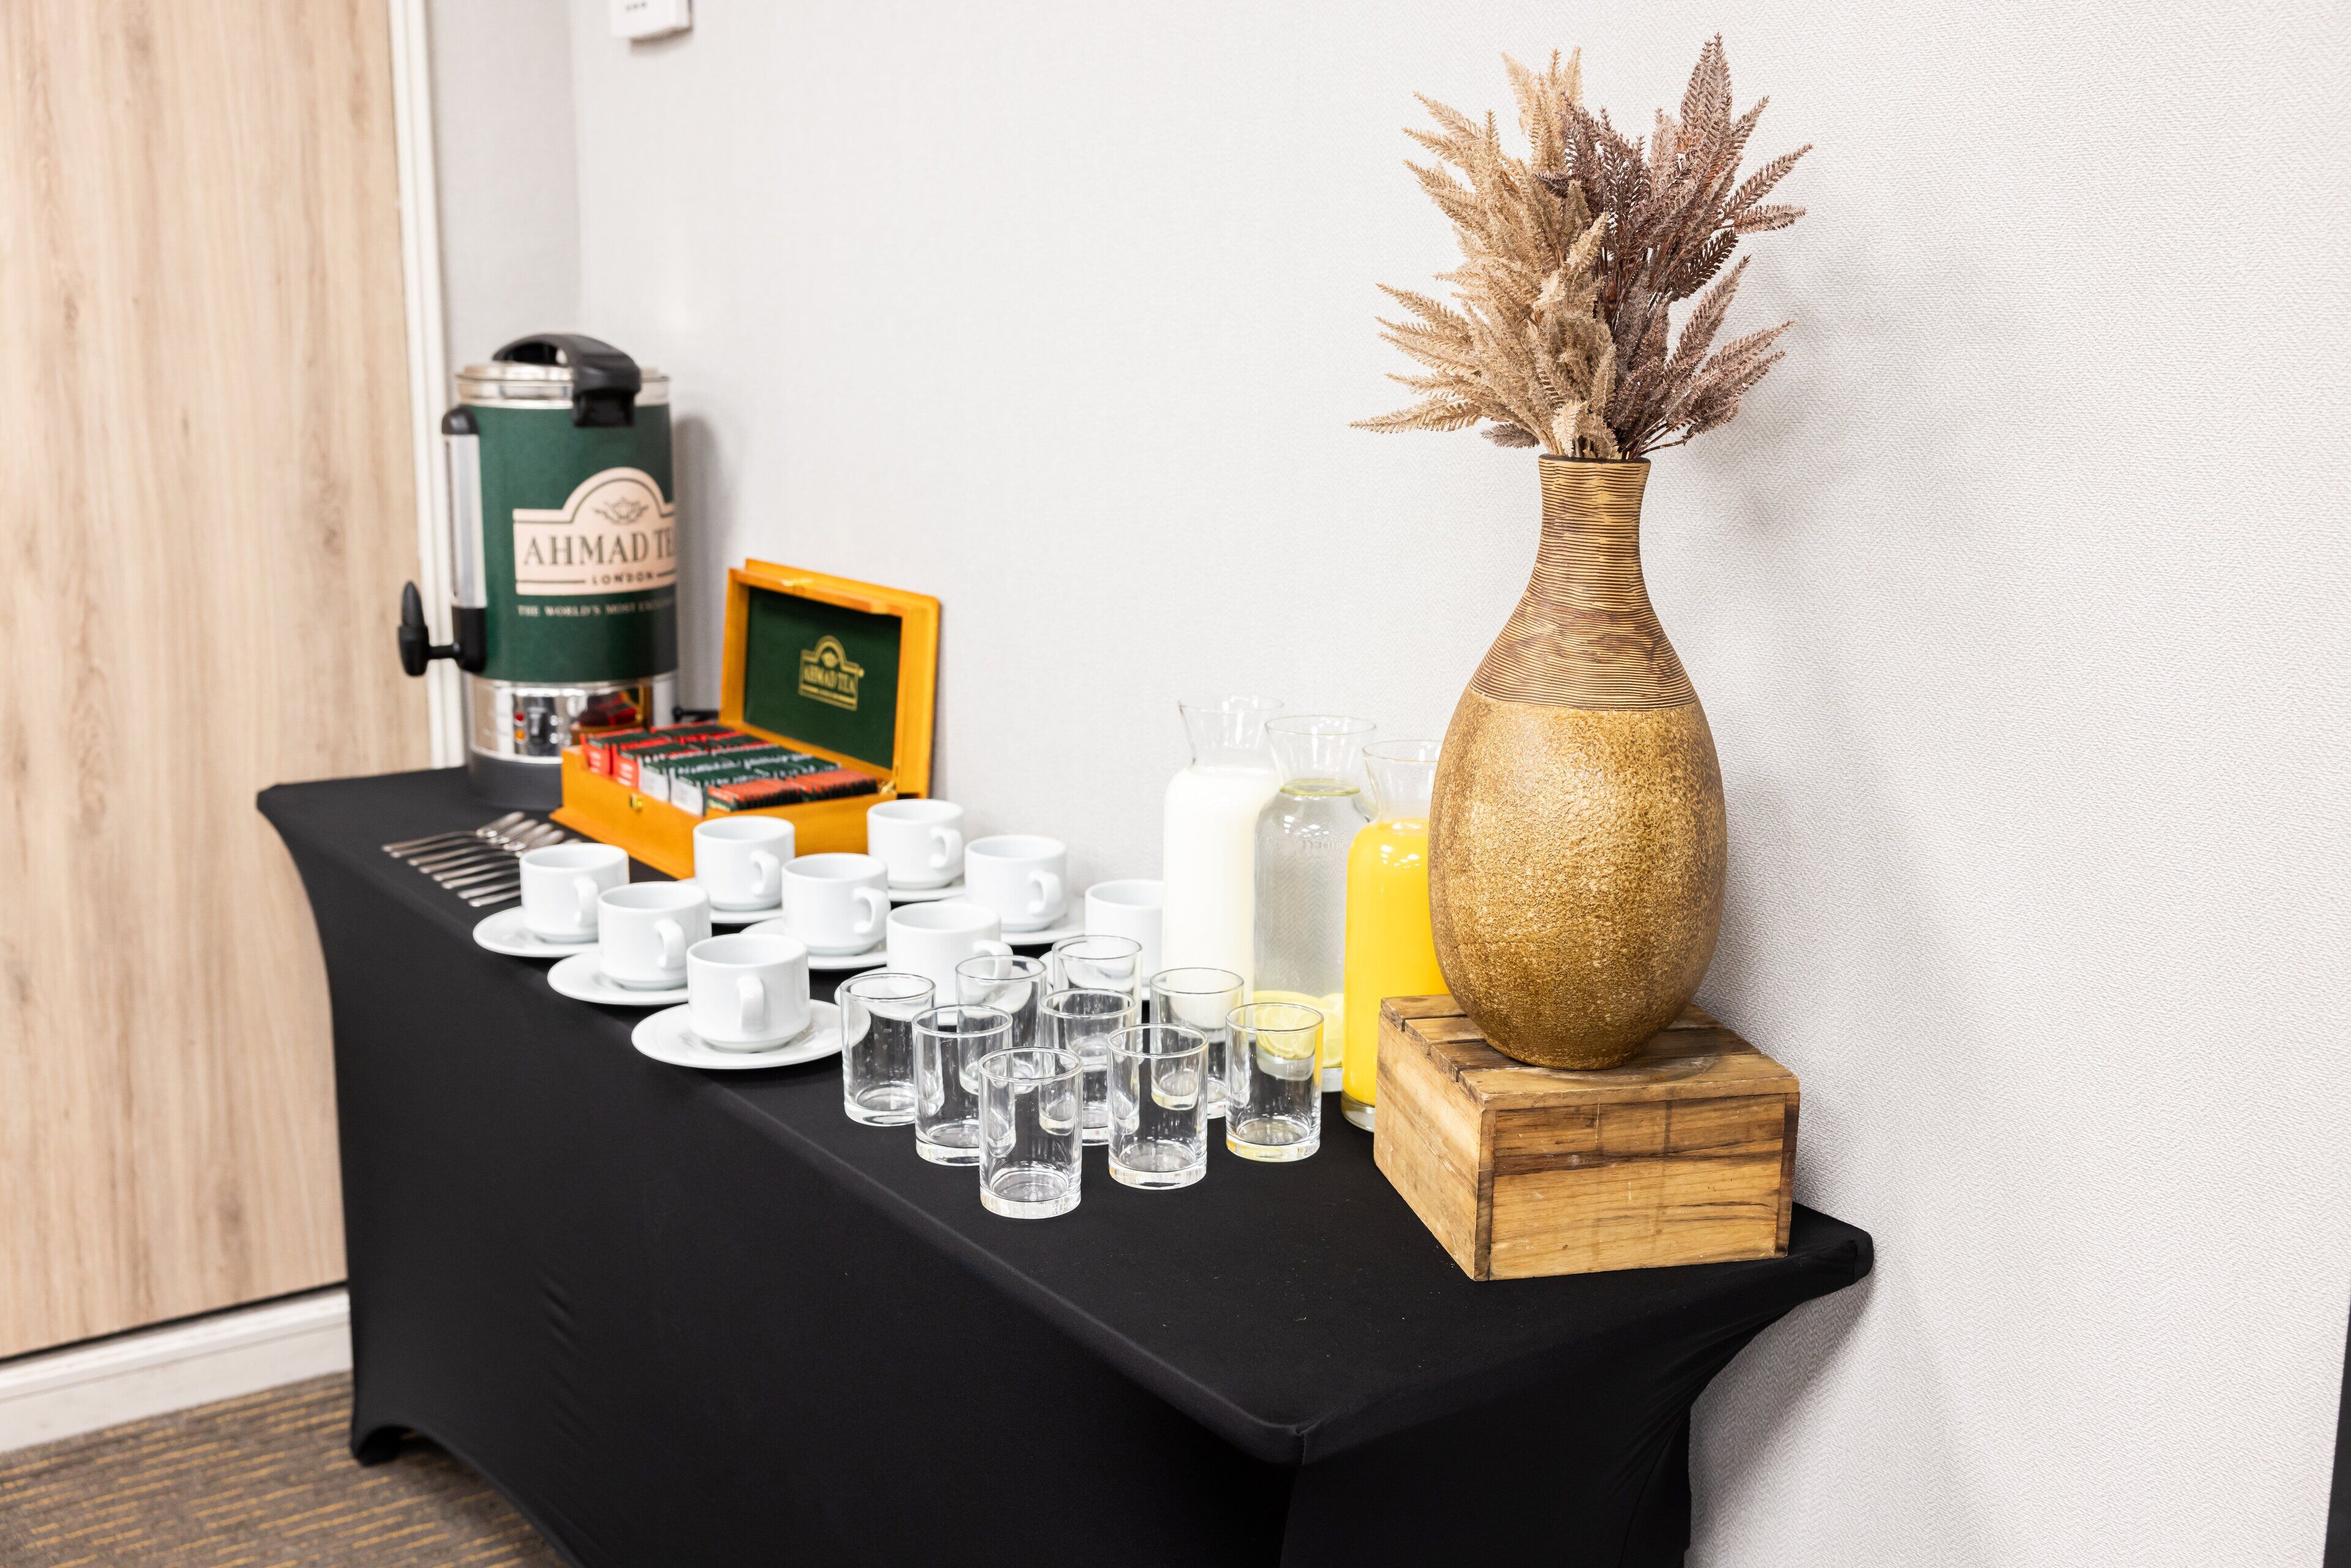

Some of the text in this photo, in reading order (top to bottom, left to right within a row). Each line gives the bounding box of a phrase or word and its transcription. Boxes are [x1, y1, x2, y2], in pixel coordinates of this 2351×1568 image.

[523, 527, 674, 566] AHMAD TE
[591, 571, 654, 585] LONDON
[517, 604, 540, 617] THE
[544, 604, 602, 617] WORLD'S
